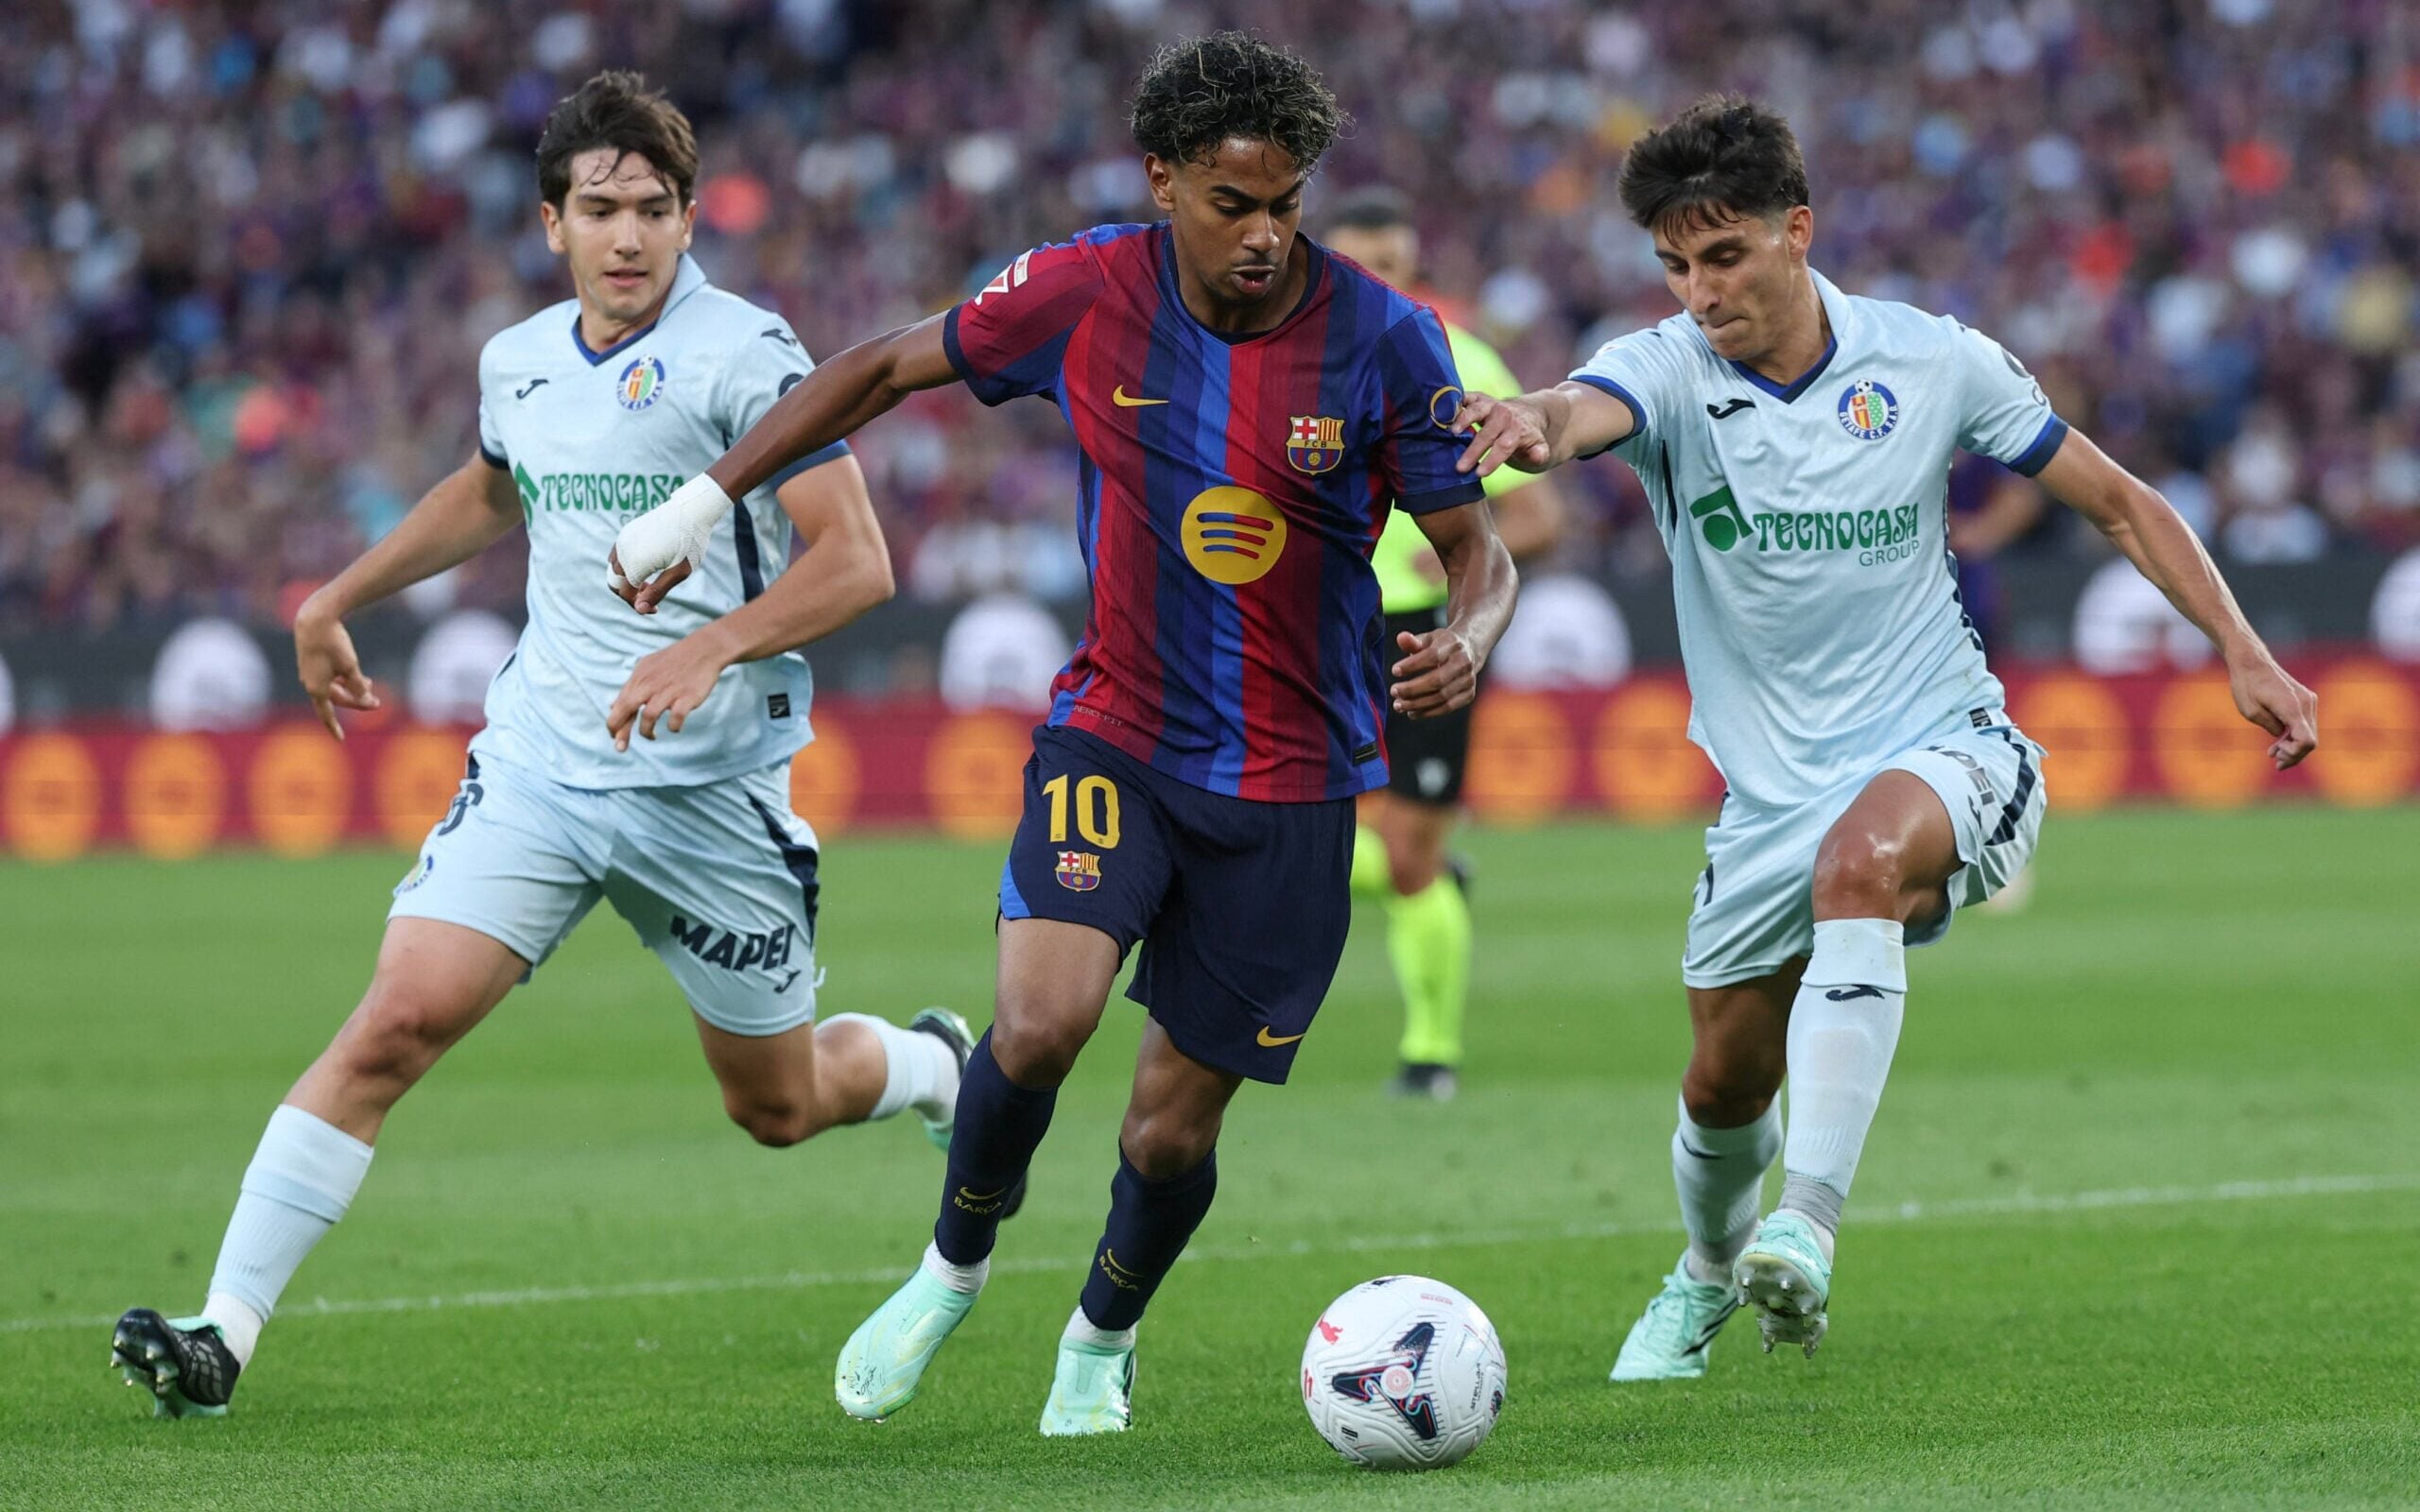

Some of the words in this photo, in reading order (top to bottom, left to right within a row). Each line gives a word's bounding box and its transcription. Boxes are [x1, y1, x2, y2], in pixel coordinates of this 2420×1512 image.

[1753, 503, 1919, 552] TECNOCASA
[1859, 540, 1921, 567] GROUP
[1042, 774, 1121, 850] 10
[670, 915, 797, 971] MAPEI
